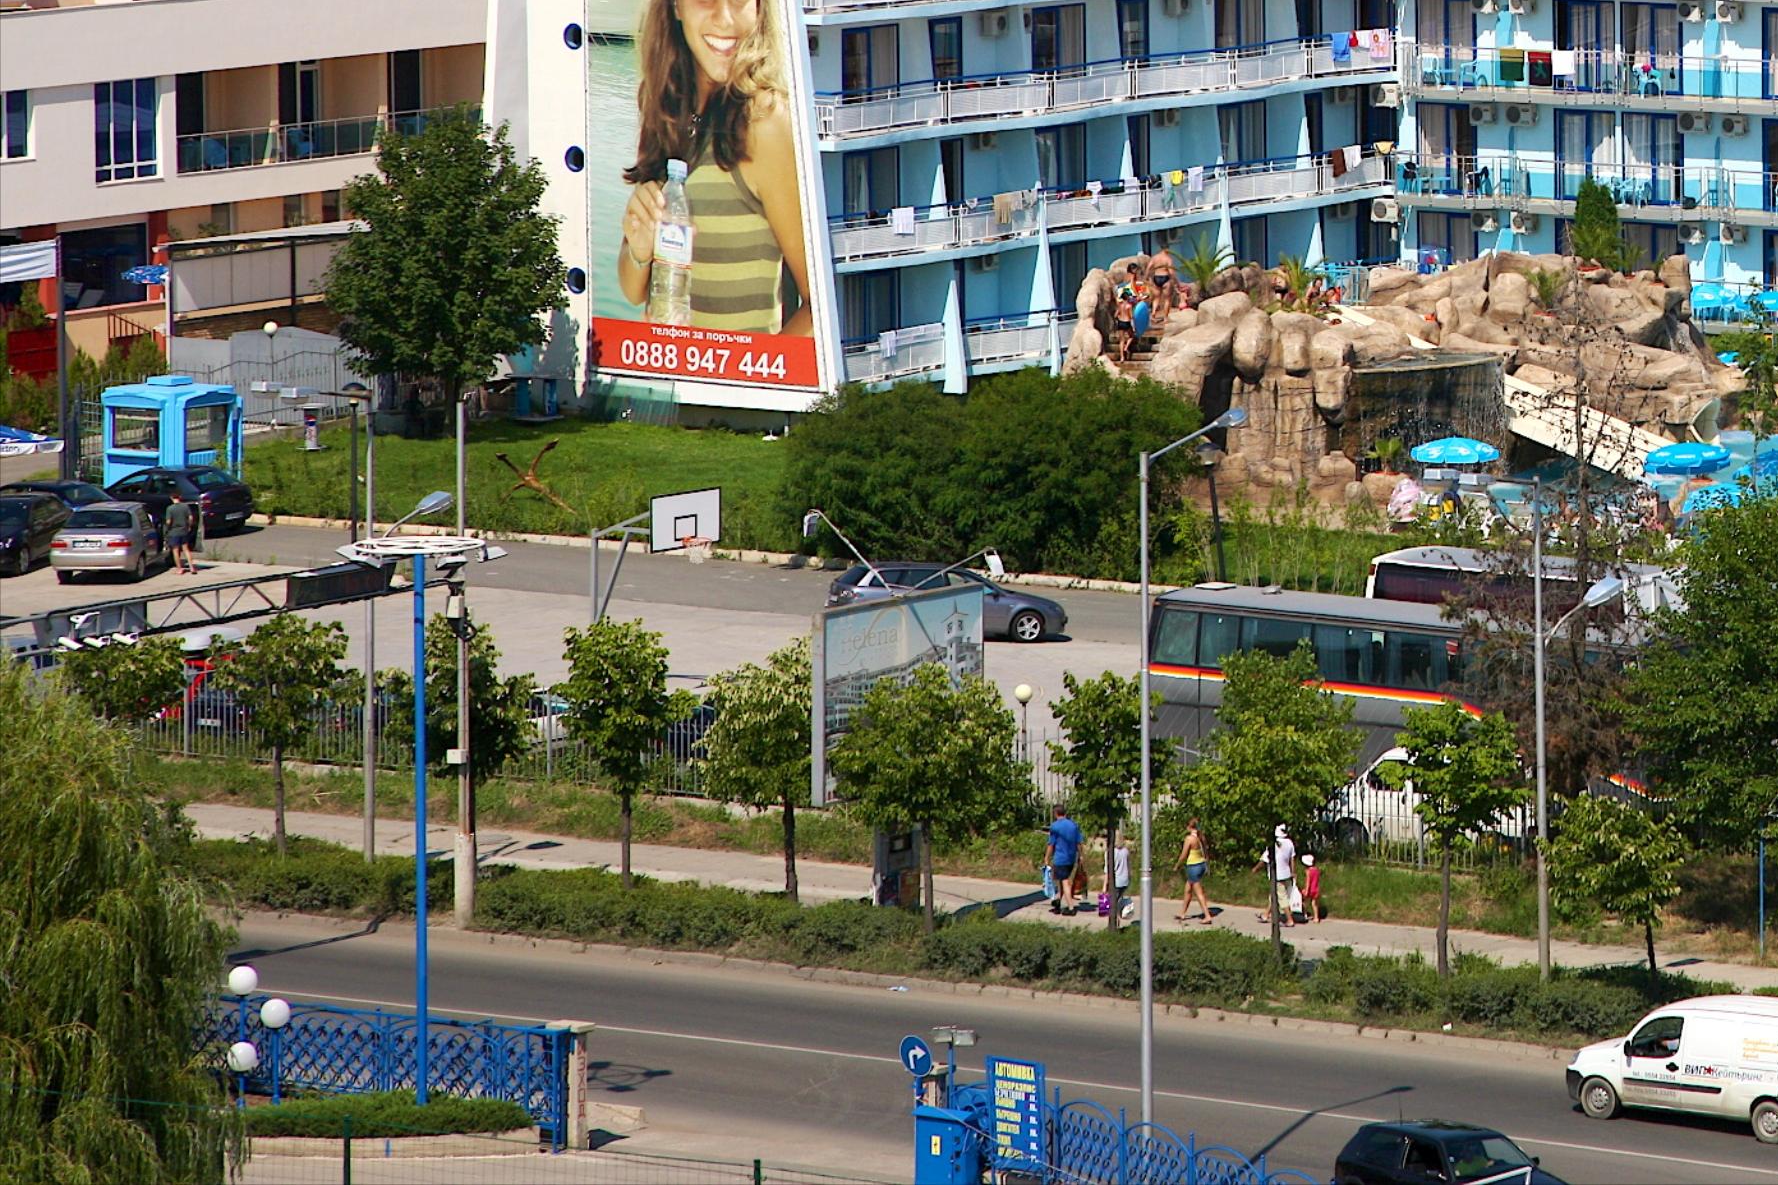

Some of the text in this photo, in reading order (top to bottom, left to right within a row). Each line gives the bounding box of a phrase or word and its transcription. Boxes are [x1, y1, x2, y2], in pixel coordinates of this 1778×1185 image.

[692, 330, 704, 340] за
[706, 331, 752, 344] поръчки
[620, 339, 787, 380] 0888 947 444
[1684, 1064, 1706, 1075] ВИП
